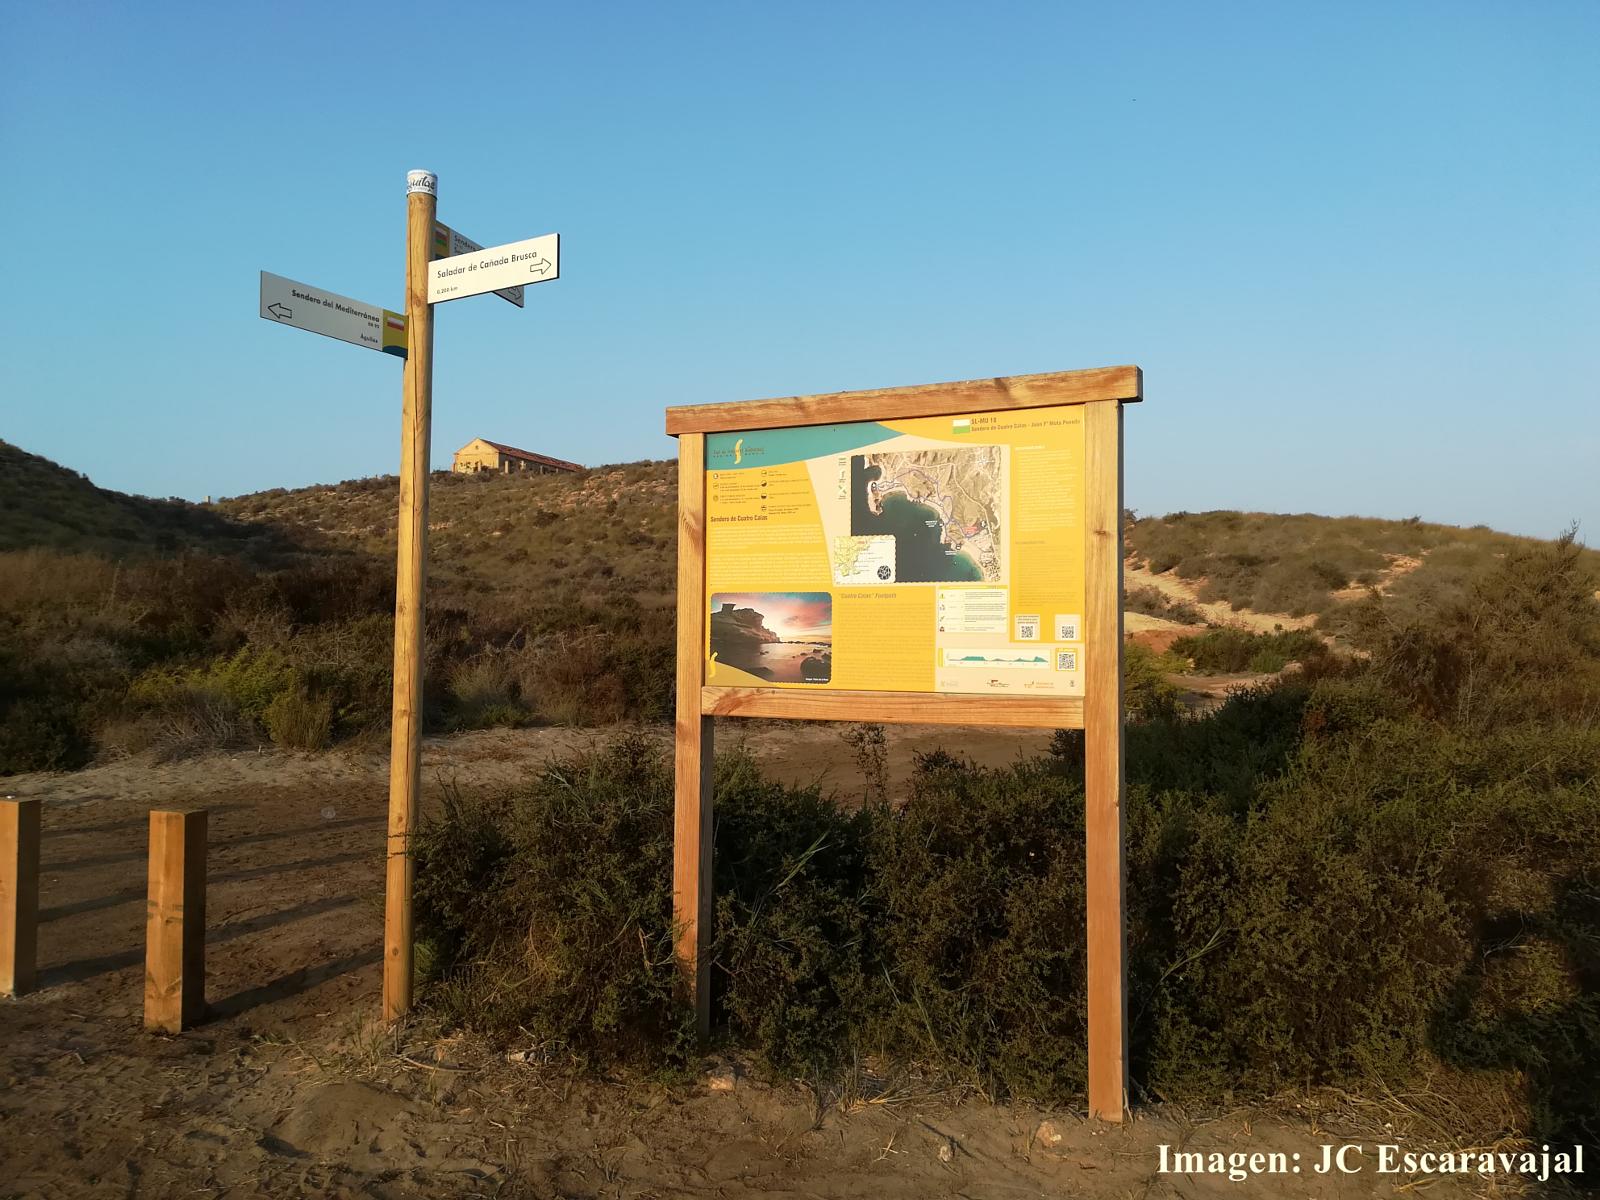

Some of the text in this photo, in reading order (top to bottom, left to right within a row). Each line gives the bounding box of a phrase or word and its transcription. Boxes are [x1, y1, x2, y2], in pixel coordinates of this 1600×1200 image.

[437, 251, 537, 279] Saladar de Cañada Brusca
[291, 289, 321, 305] Sendero
[322, 299, 334, 309] del
